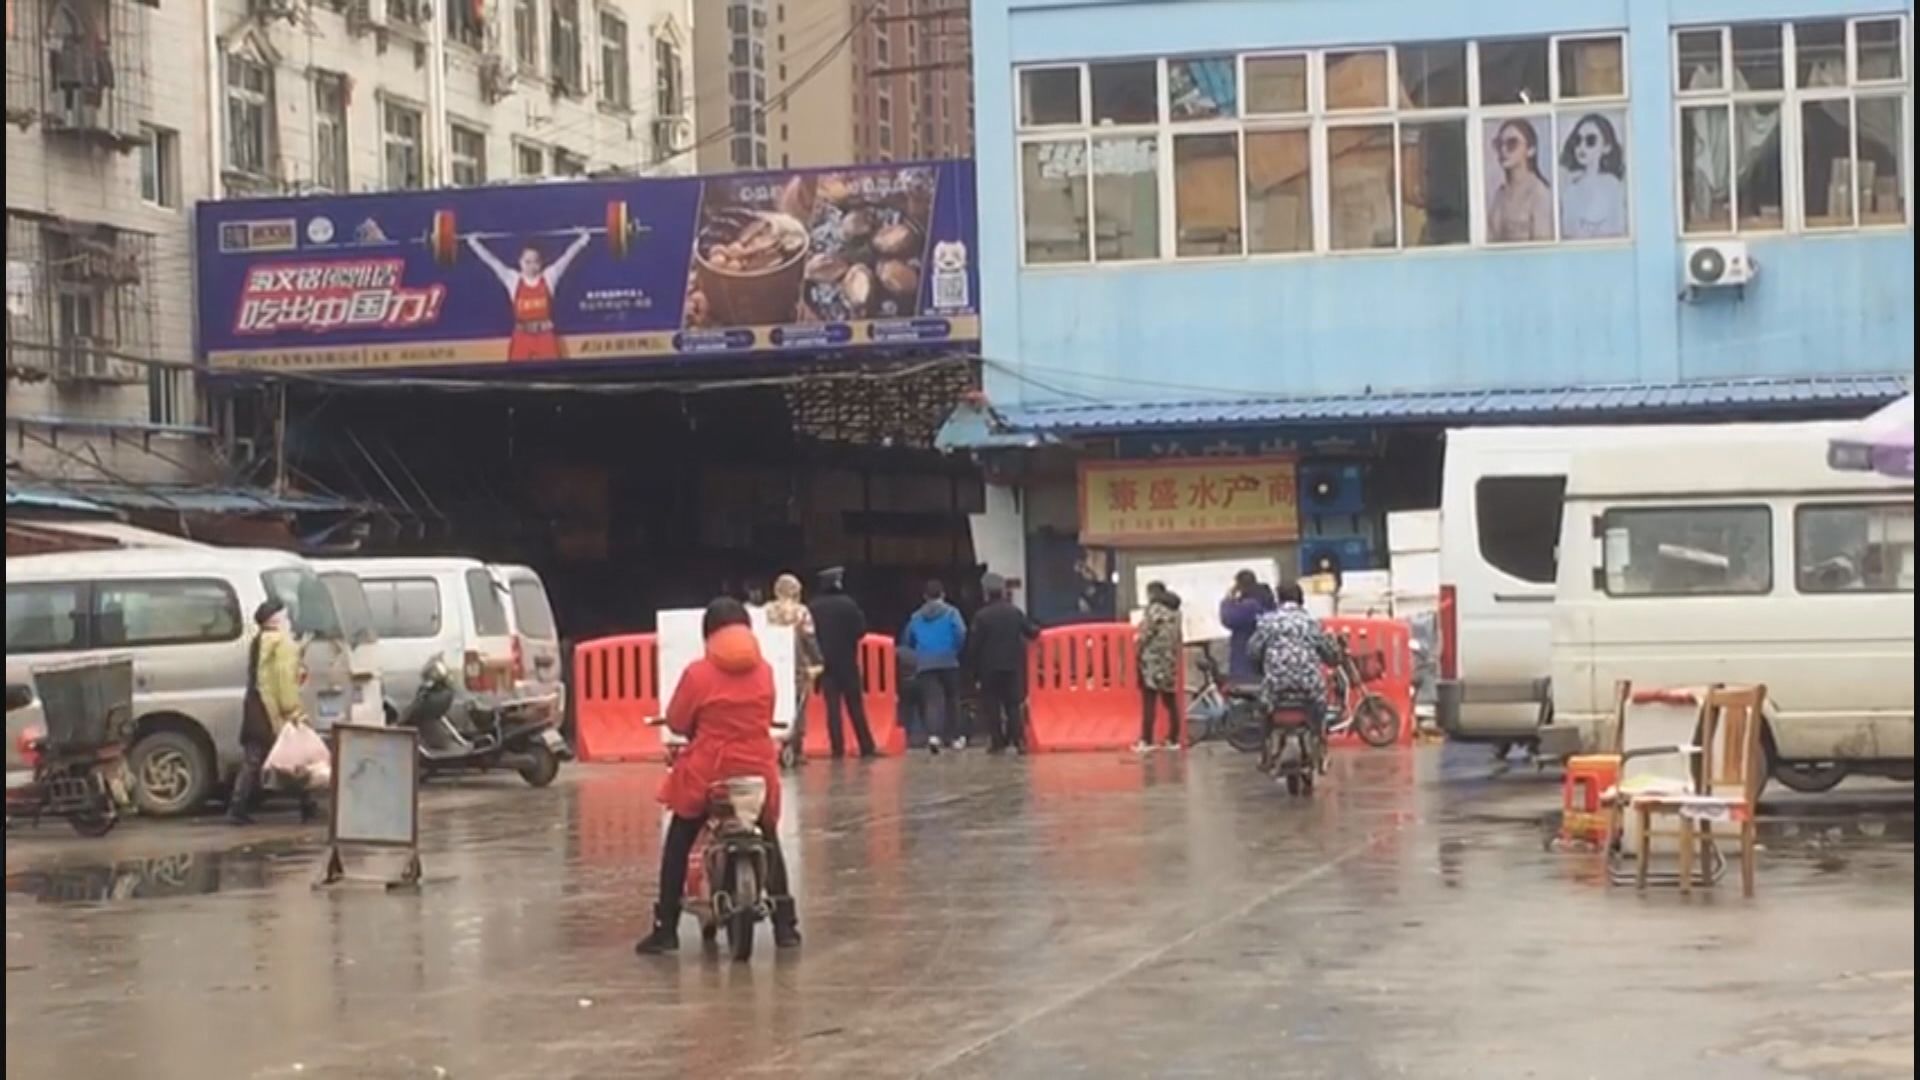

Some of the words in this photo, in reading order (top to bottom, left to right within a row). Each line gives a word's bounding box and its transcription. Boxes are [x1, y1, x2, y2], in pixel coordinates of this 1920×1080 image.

[238, 288, 441, 331] 吃出中国力!
